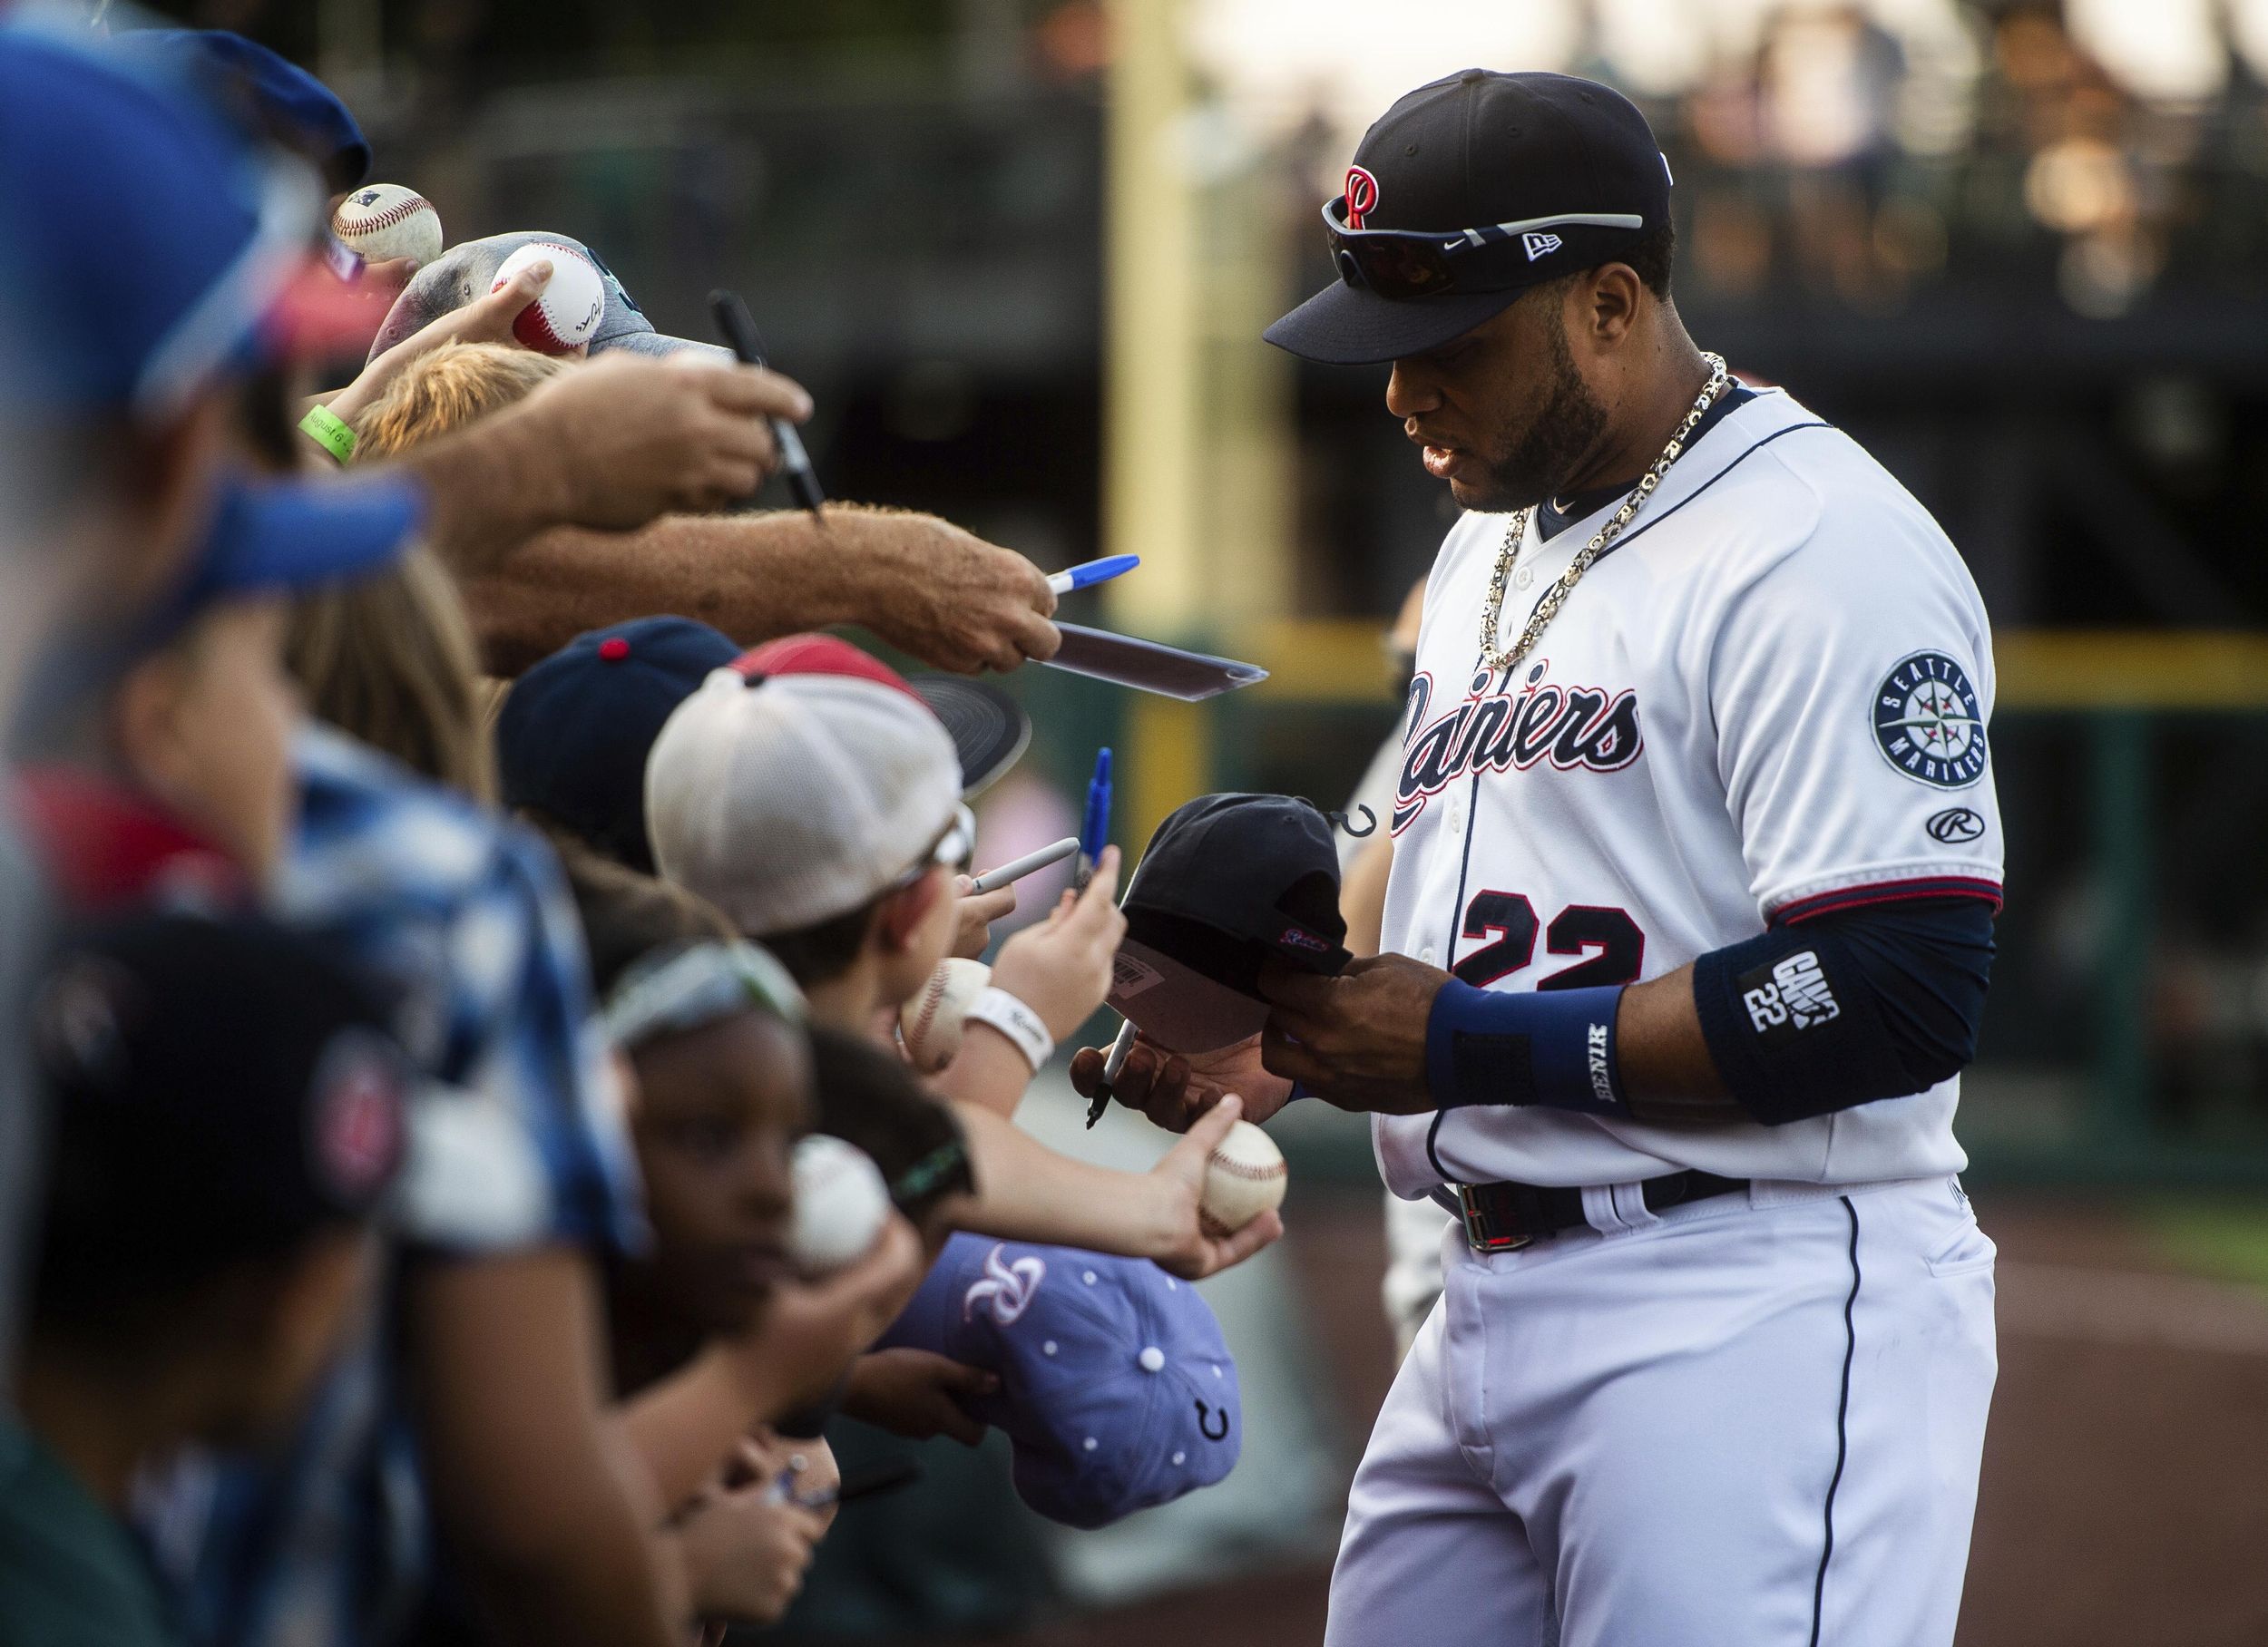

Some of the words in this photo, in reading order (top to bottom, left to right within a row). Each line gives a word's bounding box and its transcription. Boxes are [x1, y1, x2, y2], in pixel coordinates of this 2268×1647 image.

[309, 413, 336, 435] August
[334, 433, 344, 443] 6
[1882, 658, 1975, 708] SEATTLE
[1888, 733, 1984, 781] MARINERS
[1452, 889, 1645, 990] 22
[1743, 982, 1788, 1032] 22
[1773, 950, 1840, 1029] CANO
[1588, 1023, 1617, 1102] BENIK
